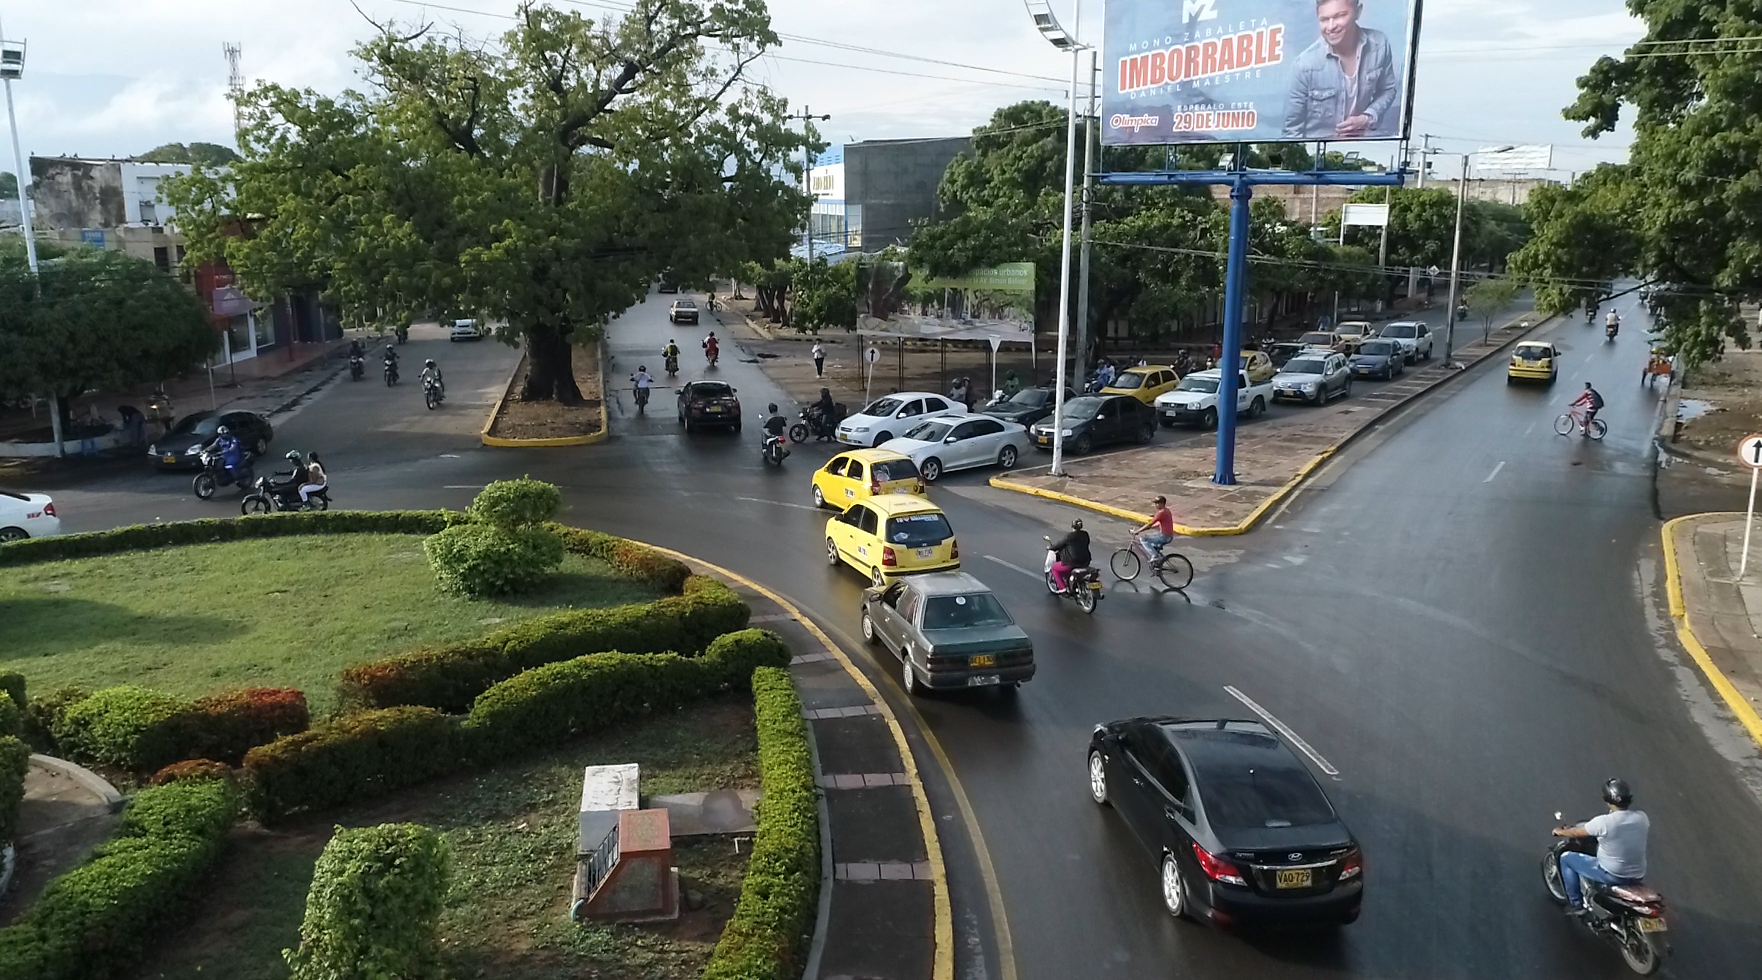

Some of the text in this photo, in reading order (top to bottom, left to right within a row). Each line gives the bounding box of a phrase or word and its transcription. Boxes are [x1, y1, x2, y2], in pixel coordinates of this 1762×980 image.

[1182, 0, 1218, 23] MZ
[1129, 17, 1268, 52] MONO ZABALETA
[1118, 23, 1284, 93] IMBORRABLE
[1130, 69, 1262, 100] DANIEL MAESTRE
[1177, 101, 1254, 112] ESPERALO ESTE
[1110, 113, 1159, 133] Olimpica
[1174, 110, 1257, 132] 29 DE JUNIO
[999, 268, 1027, 277] urbanos
